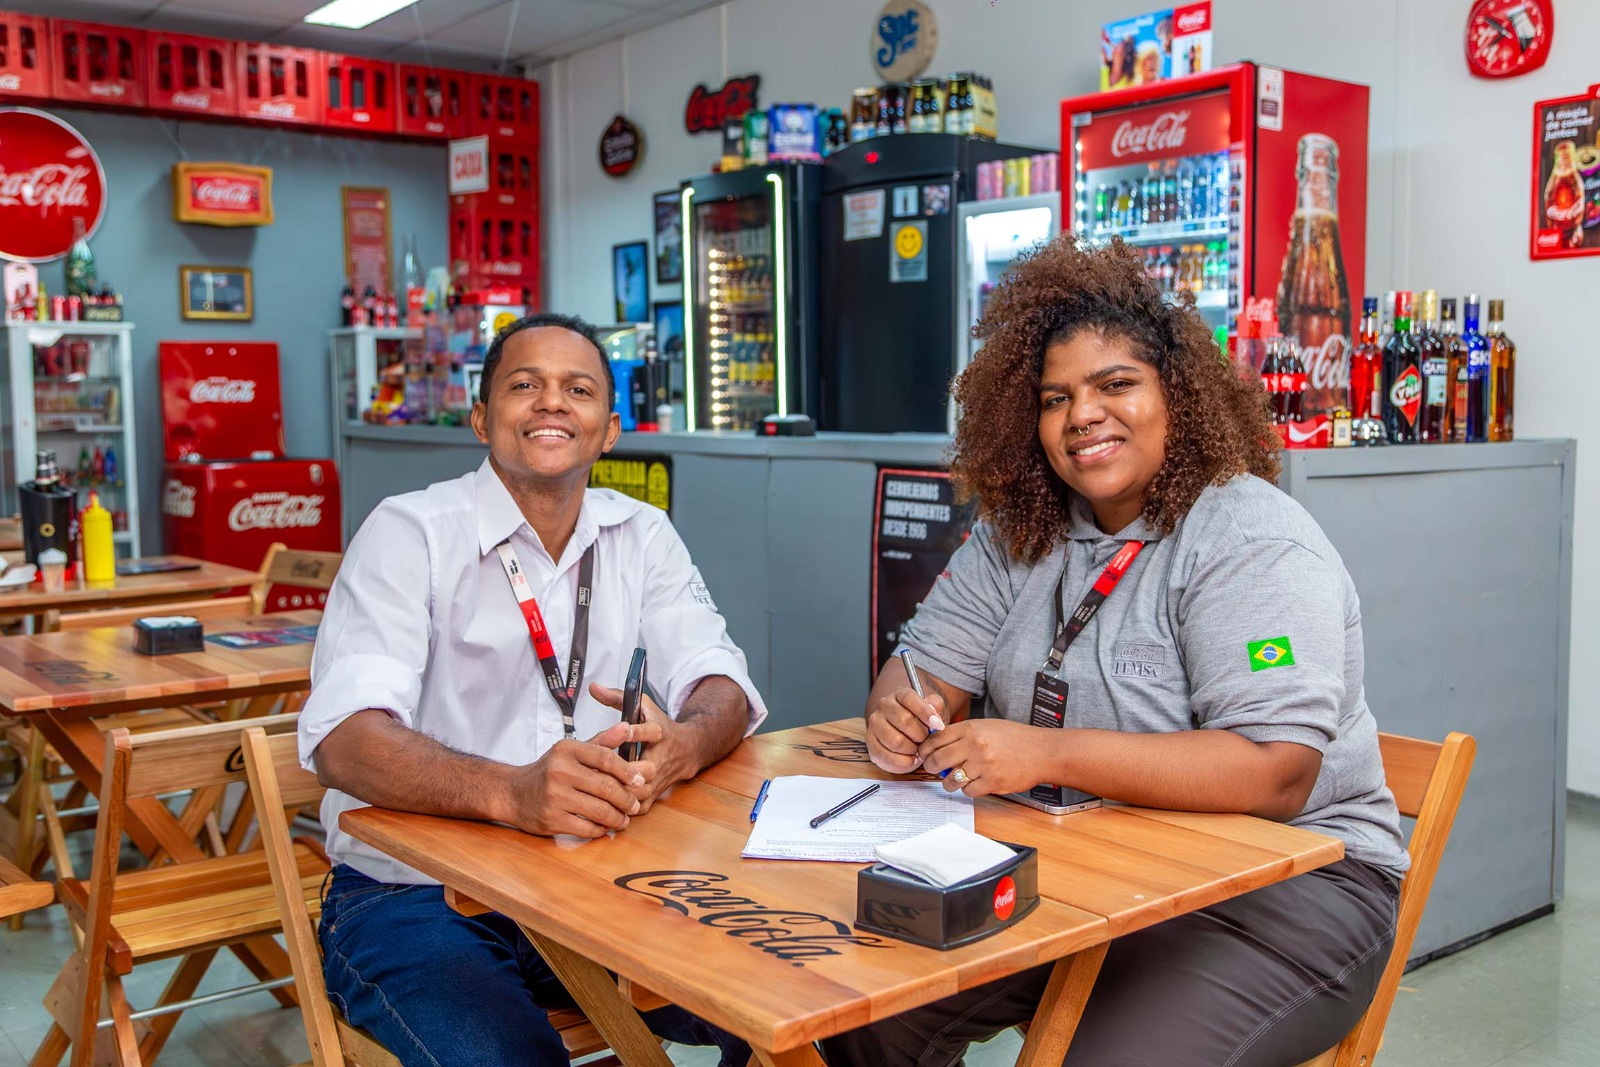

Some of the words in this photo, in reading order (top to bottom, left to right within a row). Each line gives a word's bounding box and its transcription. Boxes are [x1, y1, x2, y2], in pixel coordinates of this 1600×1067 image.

[1112, 111, 1191, 157] Coca-Cola
[886, 480, 939, 501] CERVEJEIROS
[228, 496, 324, 531] Coca-Cola
[884, 499, 951, 522] INDEPENDENTES
[882, 518, 908, 538] DESDE
[908, 522, 928, 540] 1906
[614, 870, 898, 962] Coca-Cola
